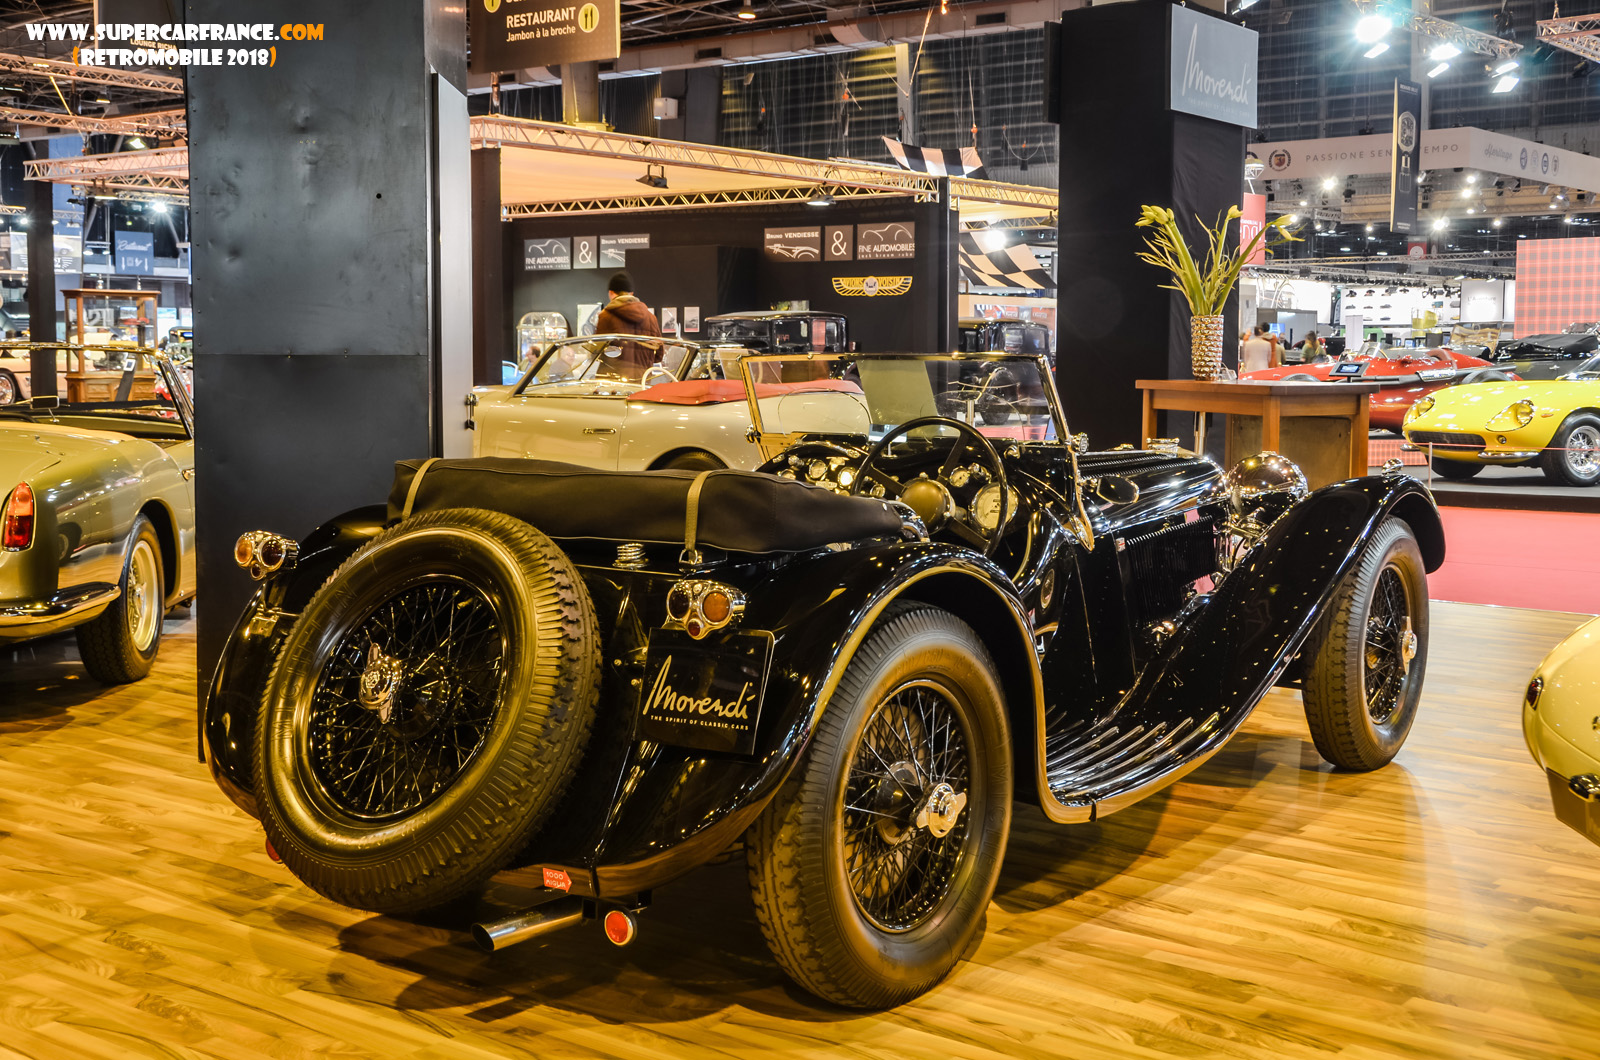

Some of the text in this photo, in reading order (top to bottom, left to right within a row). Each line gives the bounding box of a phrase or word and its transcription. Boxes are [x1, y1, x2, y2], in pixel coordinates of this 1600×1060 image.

[506, 7, 577, 28] RESTAURANT
[506, 24, 576, 42] Jambon à la broche
[1181, 23, 1251, 105] Movendi
[1305, 151, 1365, 162] PASSIONE
[1370, 149, 1393, 158] SEN
[1484, 143, 1513, 161] Heritage
[784, 231, 820, 239] VENDIESSE
[831, 231, 847, 256] &
[578, 240, 592, 264] &
[858, 243, 915, 253] FINE AUTOMOBILES
[525, 255, 569, 265] FINE AUTOMOBILES
[272, 580, 358, 740] MICHELIN
[642, 654, 756, 719] Movendi
[665, 716, 687, 724] SPIRIT
[700, 720, 728, 729] CLASSIC
[731, 723, 749, 731] CARS
[956, 763, 1010, 926] MICHELIN
[546, 871, 564, 880] 1000
